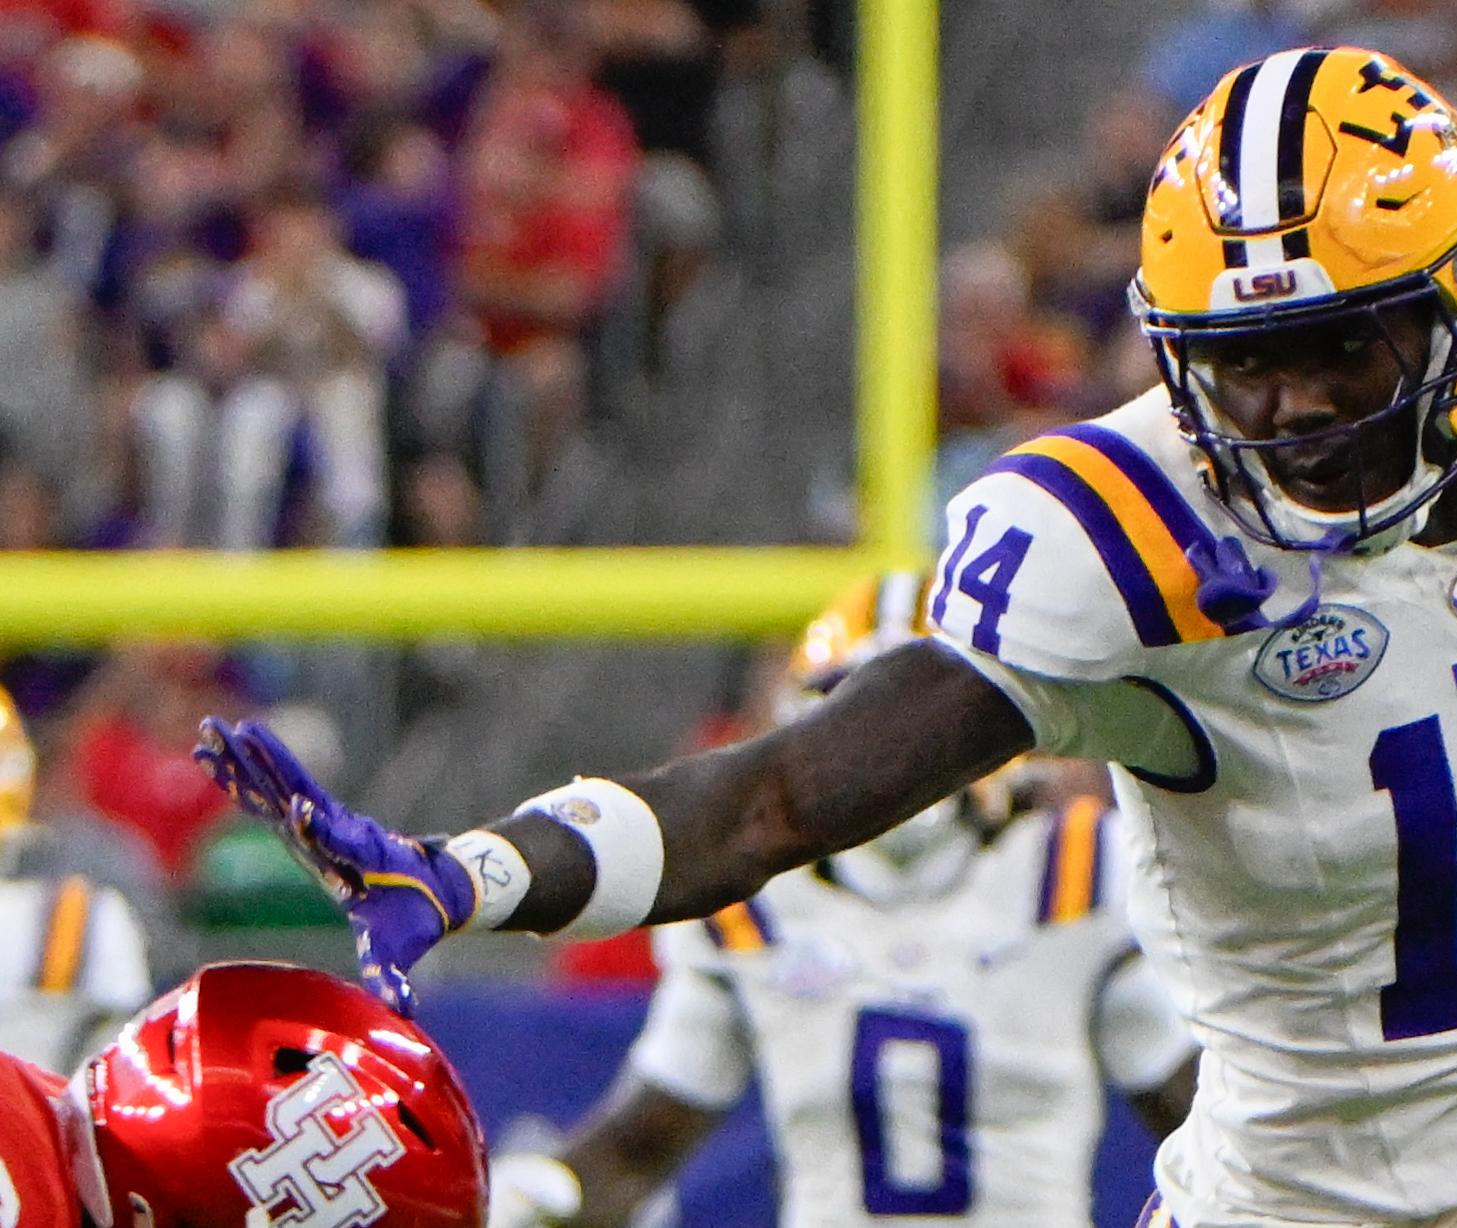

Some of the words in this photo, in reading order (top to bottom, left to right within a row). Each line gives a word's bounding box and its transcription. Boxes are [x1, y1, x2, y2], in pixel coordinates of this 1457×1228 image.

[1233, 269, 1297, 302] LSU
[931, 503, 1034, 656] 14
[1275, 628, 1371, 680] TEXAS
[851, 1003, 975, 1216] 0
